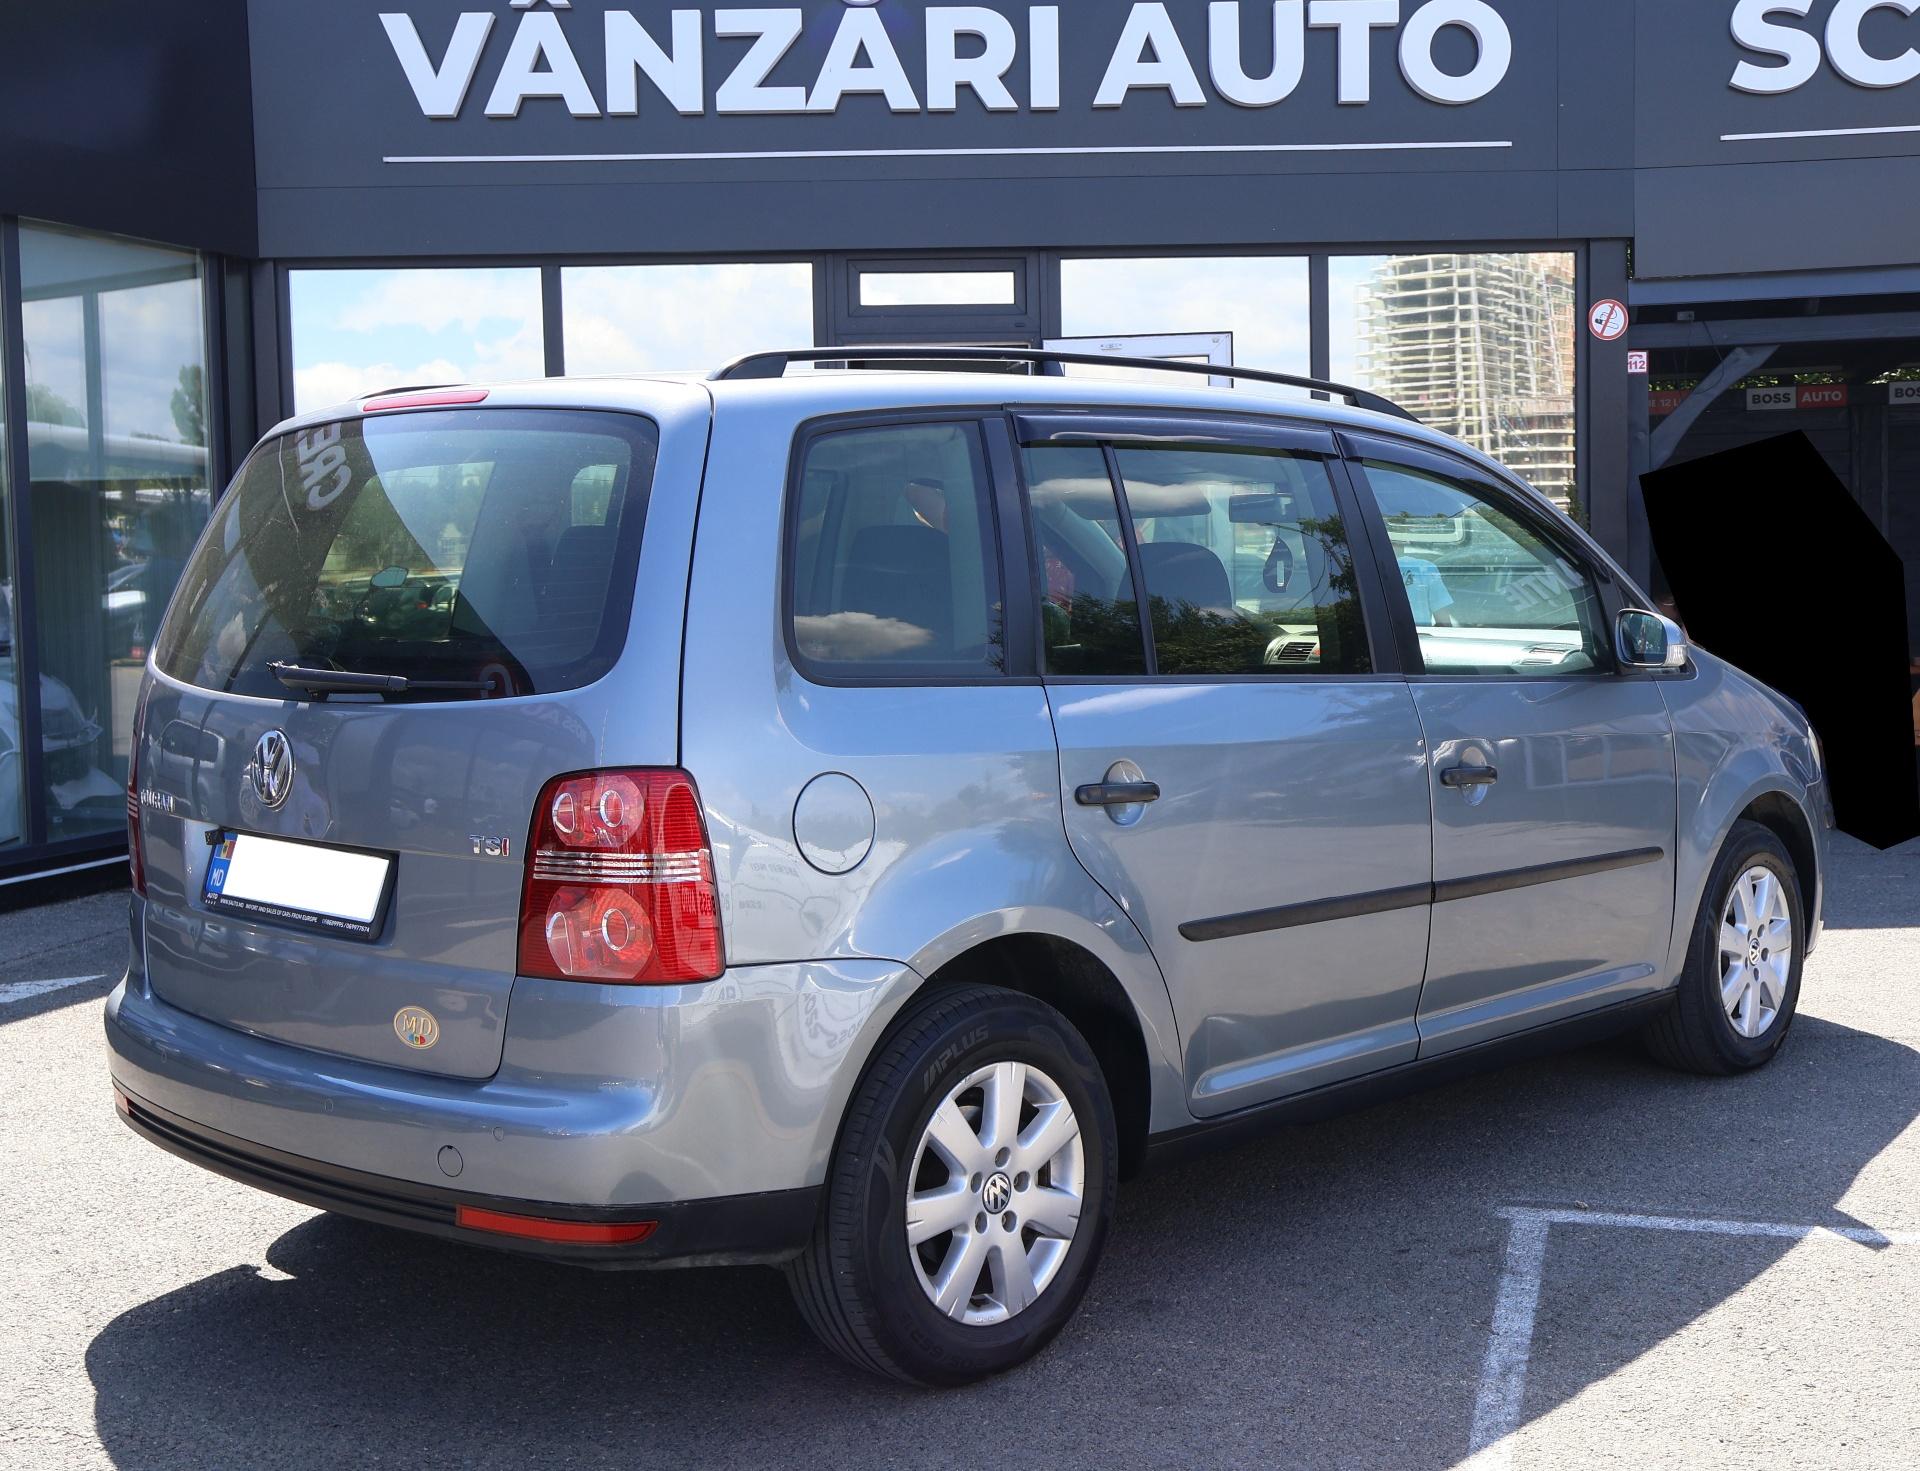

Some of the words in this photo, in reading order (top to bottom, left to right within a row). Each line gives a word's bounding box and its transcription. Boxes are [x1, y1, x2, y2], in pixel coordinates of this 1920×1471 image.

[1093, 0, 1512, 108] AUTO
[1628, 359, 1647, 370] 112
[1751, 392, 1791, 405] BOSS
[1801, 390, 1842, 403] AUTO
[469, 834, 510, 857] TSI
[211, 867, 225, 887] MD
[403, 1013, 433, 1035] MD
